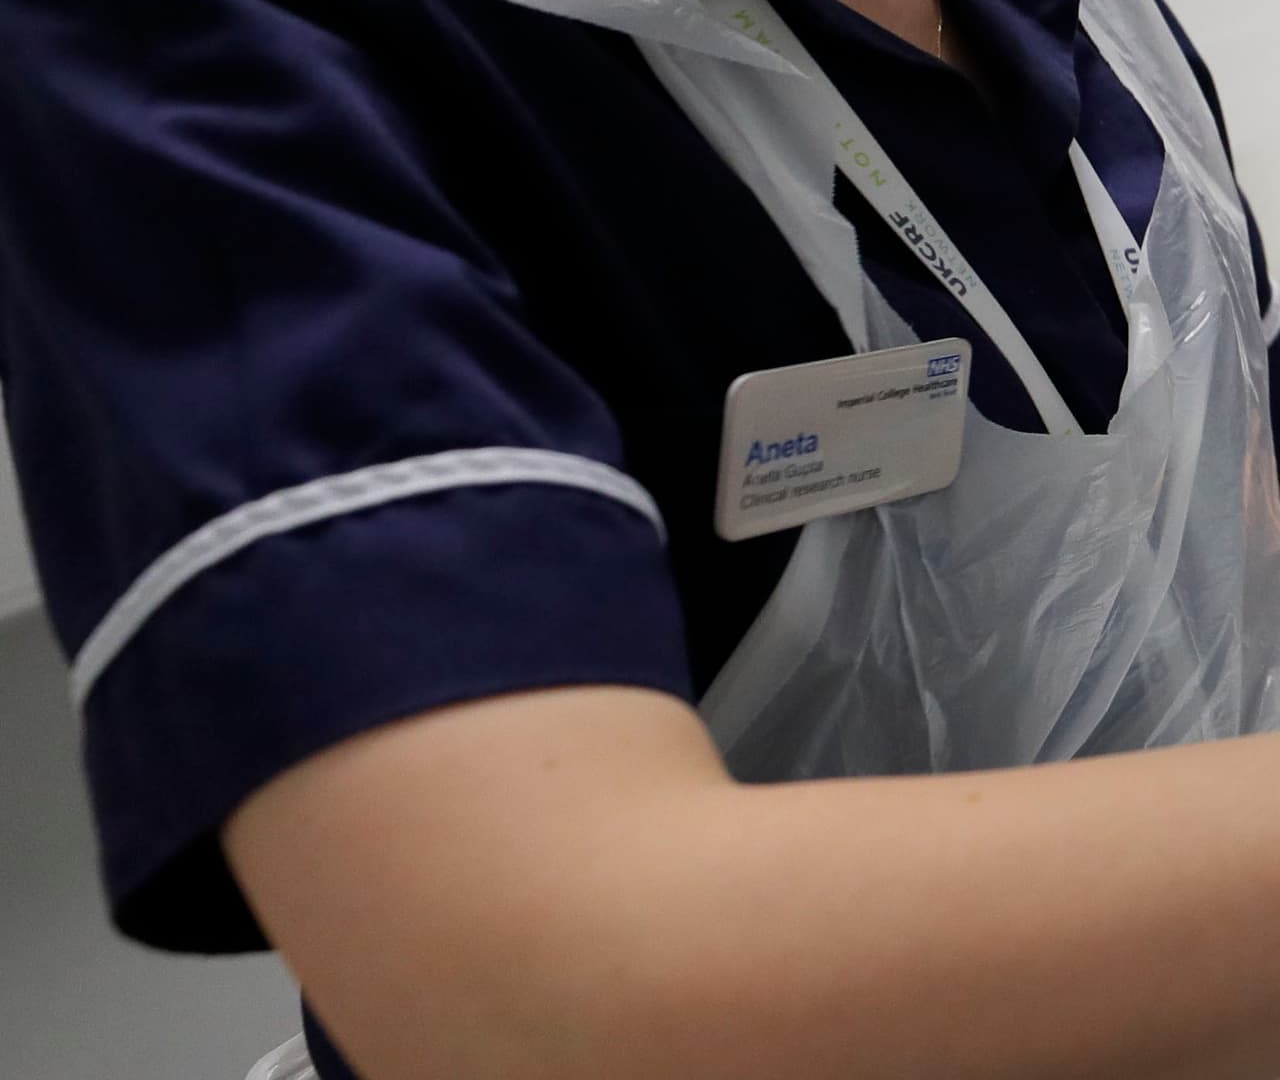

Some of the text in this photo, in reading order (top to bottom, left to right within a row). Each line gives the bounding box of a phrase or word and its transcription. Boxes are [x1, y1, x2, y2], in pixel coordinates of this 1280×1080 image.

[888, 211, 967, 297] UKCRF
[929, 356, 960, 377] NHS
[744, 432, 819, 467] Aneta
[791, 475, 845, 497] research
[848, 468, 881, 485] nurse
